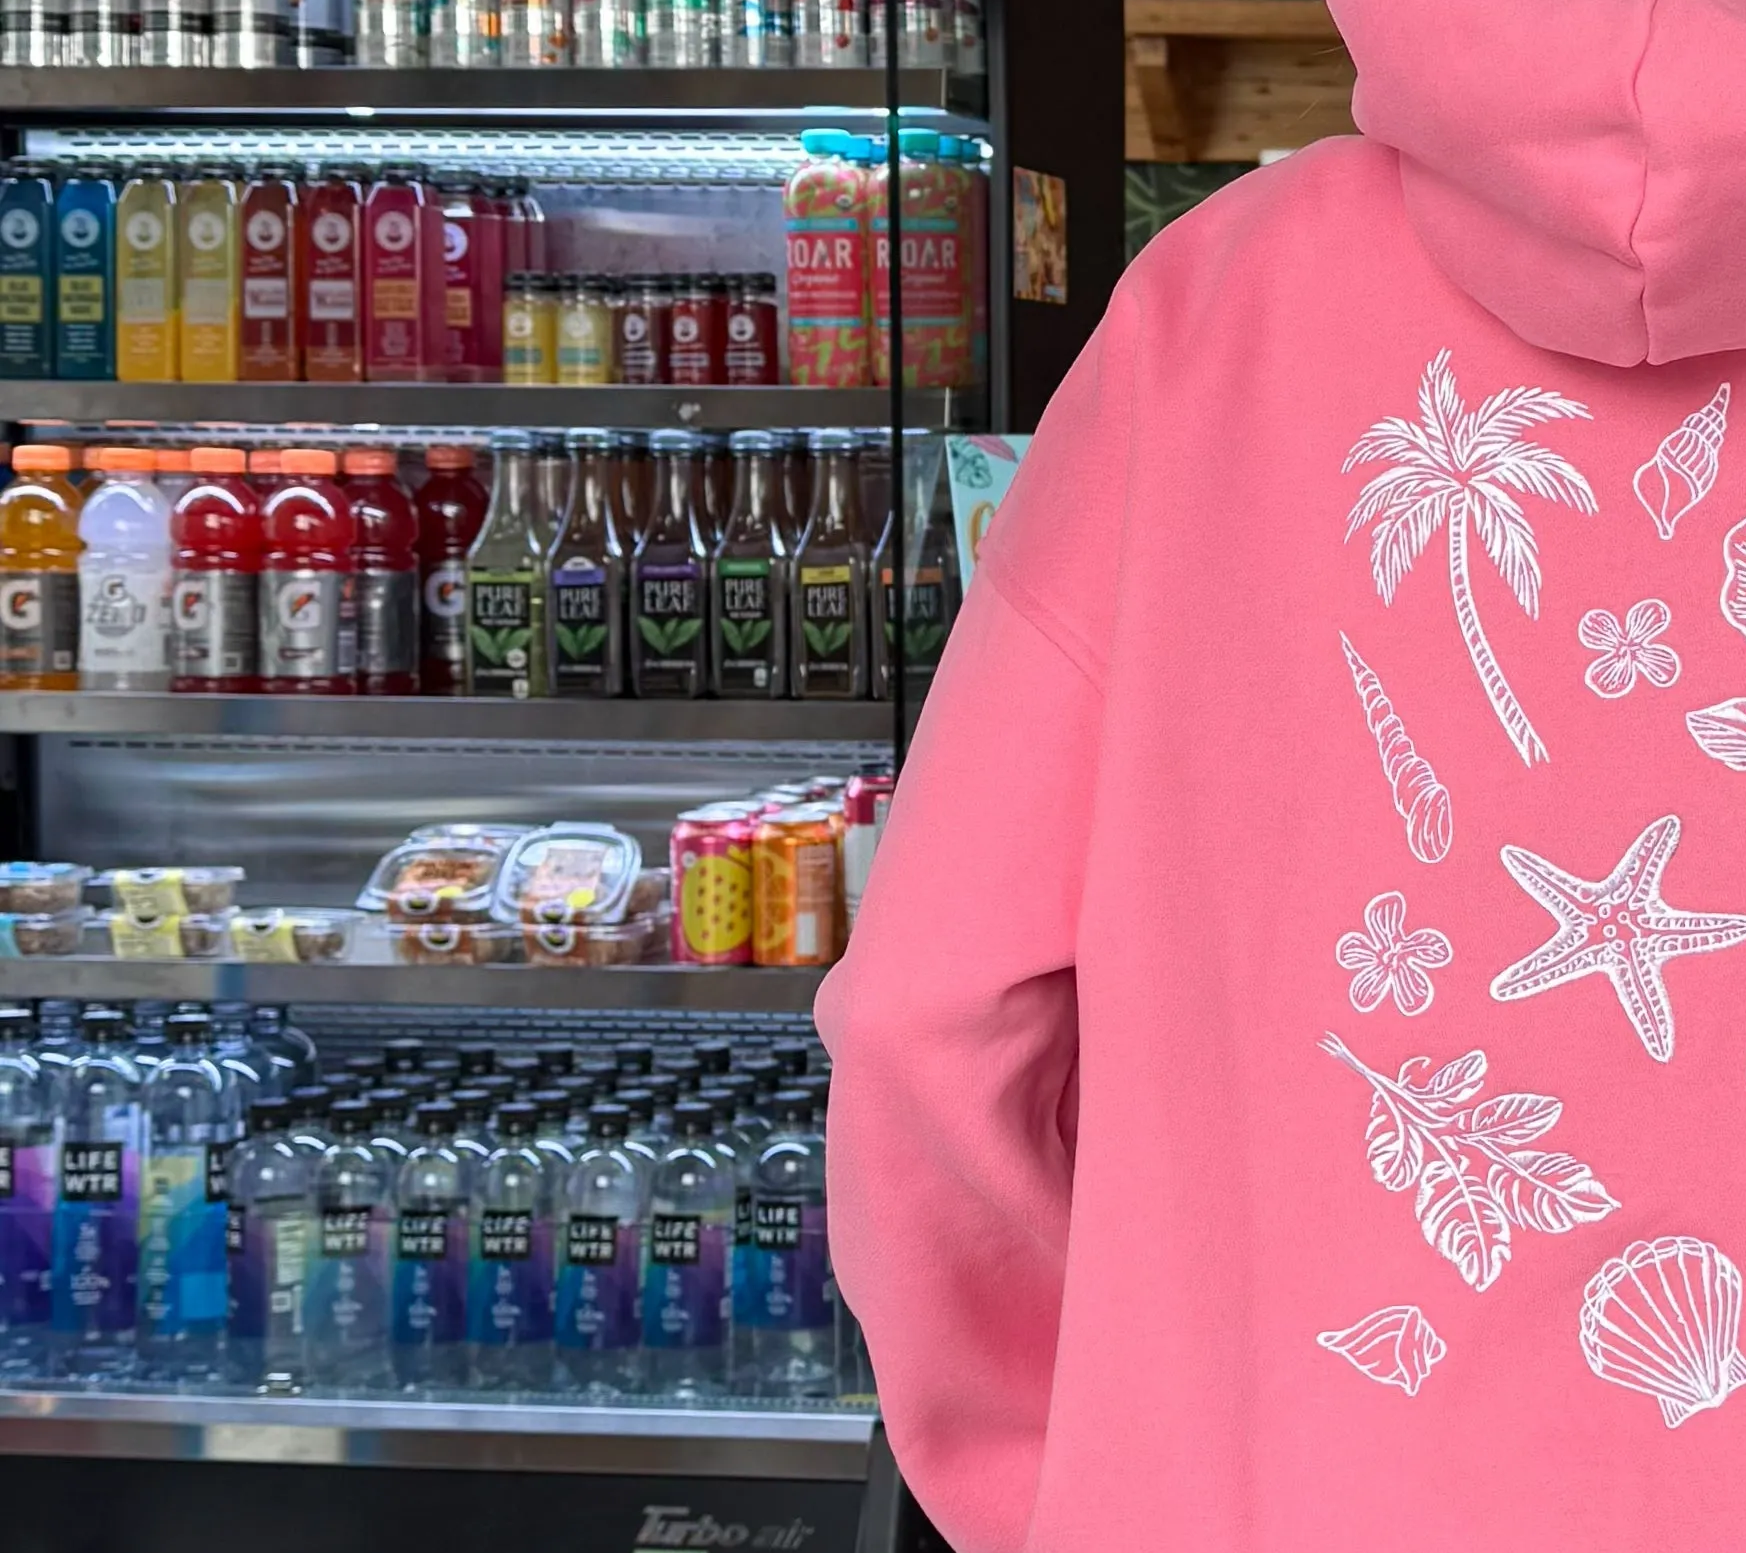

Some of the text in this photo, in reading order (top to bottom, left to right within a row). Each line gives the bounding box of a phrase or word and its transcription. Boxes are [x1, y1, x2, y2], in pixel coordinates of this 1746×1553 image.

[476, 585, 527, 601] PURE
[560, 587, 601, 602] PURE
[644, 580, 694, 597] PURE
[725, 579, 764, 594] PURE
[808, 585, 847, 600] PURE
[476, 601, 527, 617] LEAF
[645, 597, 692, 613] LEAF
[726, 594, 763, 610] LEAF
[808, 600, 846, 617] LEAF
[560, 603, 600, 619] LEAF
[65, 1150, 118, 1170] LIFE
[65, 1174, 118, 1193] WTR
[325, 1214, 368, 1231] LIFE
[758, 1207, 798, 1224] LIFE
[402, 1216, 445, 1233] LIFE
[483, 1216, 529, 1234] LIFE
[654, 1222, 697, 1239] LIFE
[402, 1236, 444, 1253] WTR
[484, 1236, 528, 1254] WTR
[570, 1241, 613, 1259] WTR
[654, 1241, 697, 1259] WTR
[634, 1505, 749, 1548] Turbo
